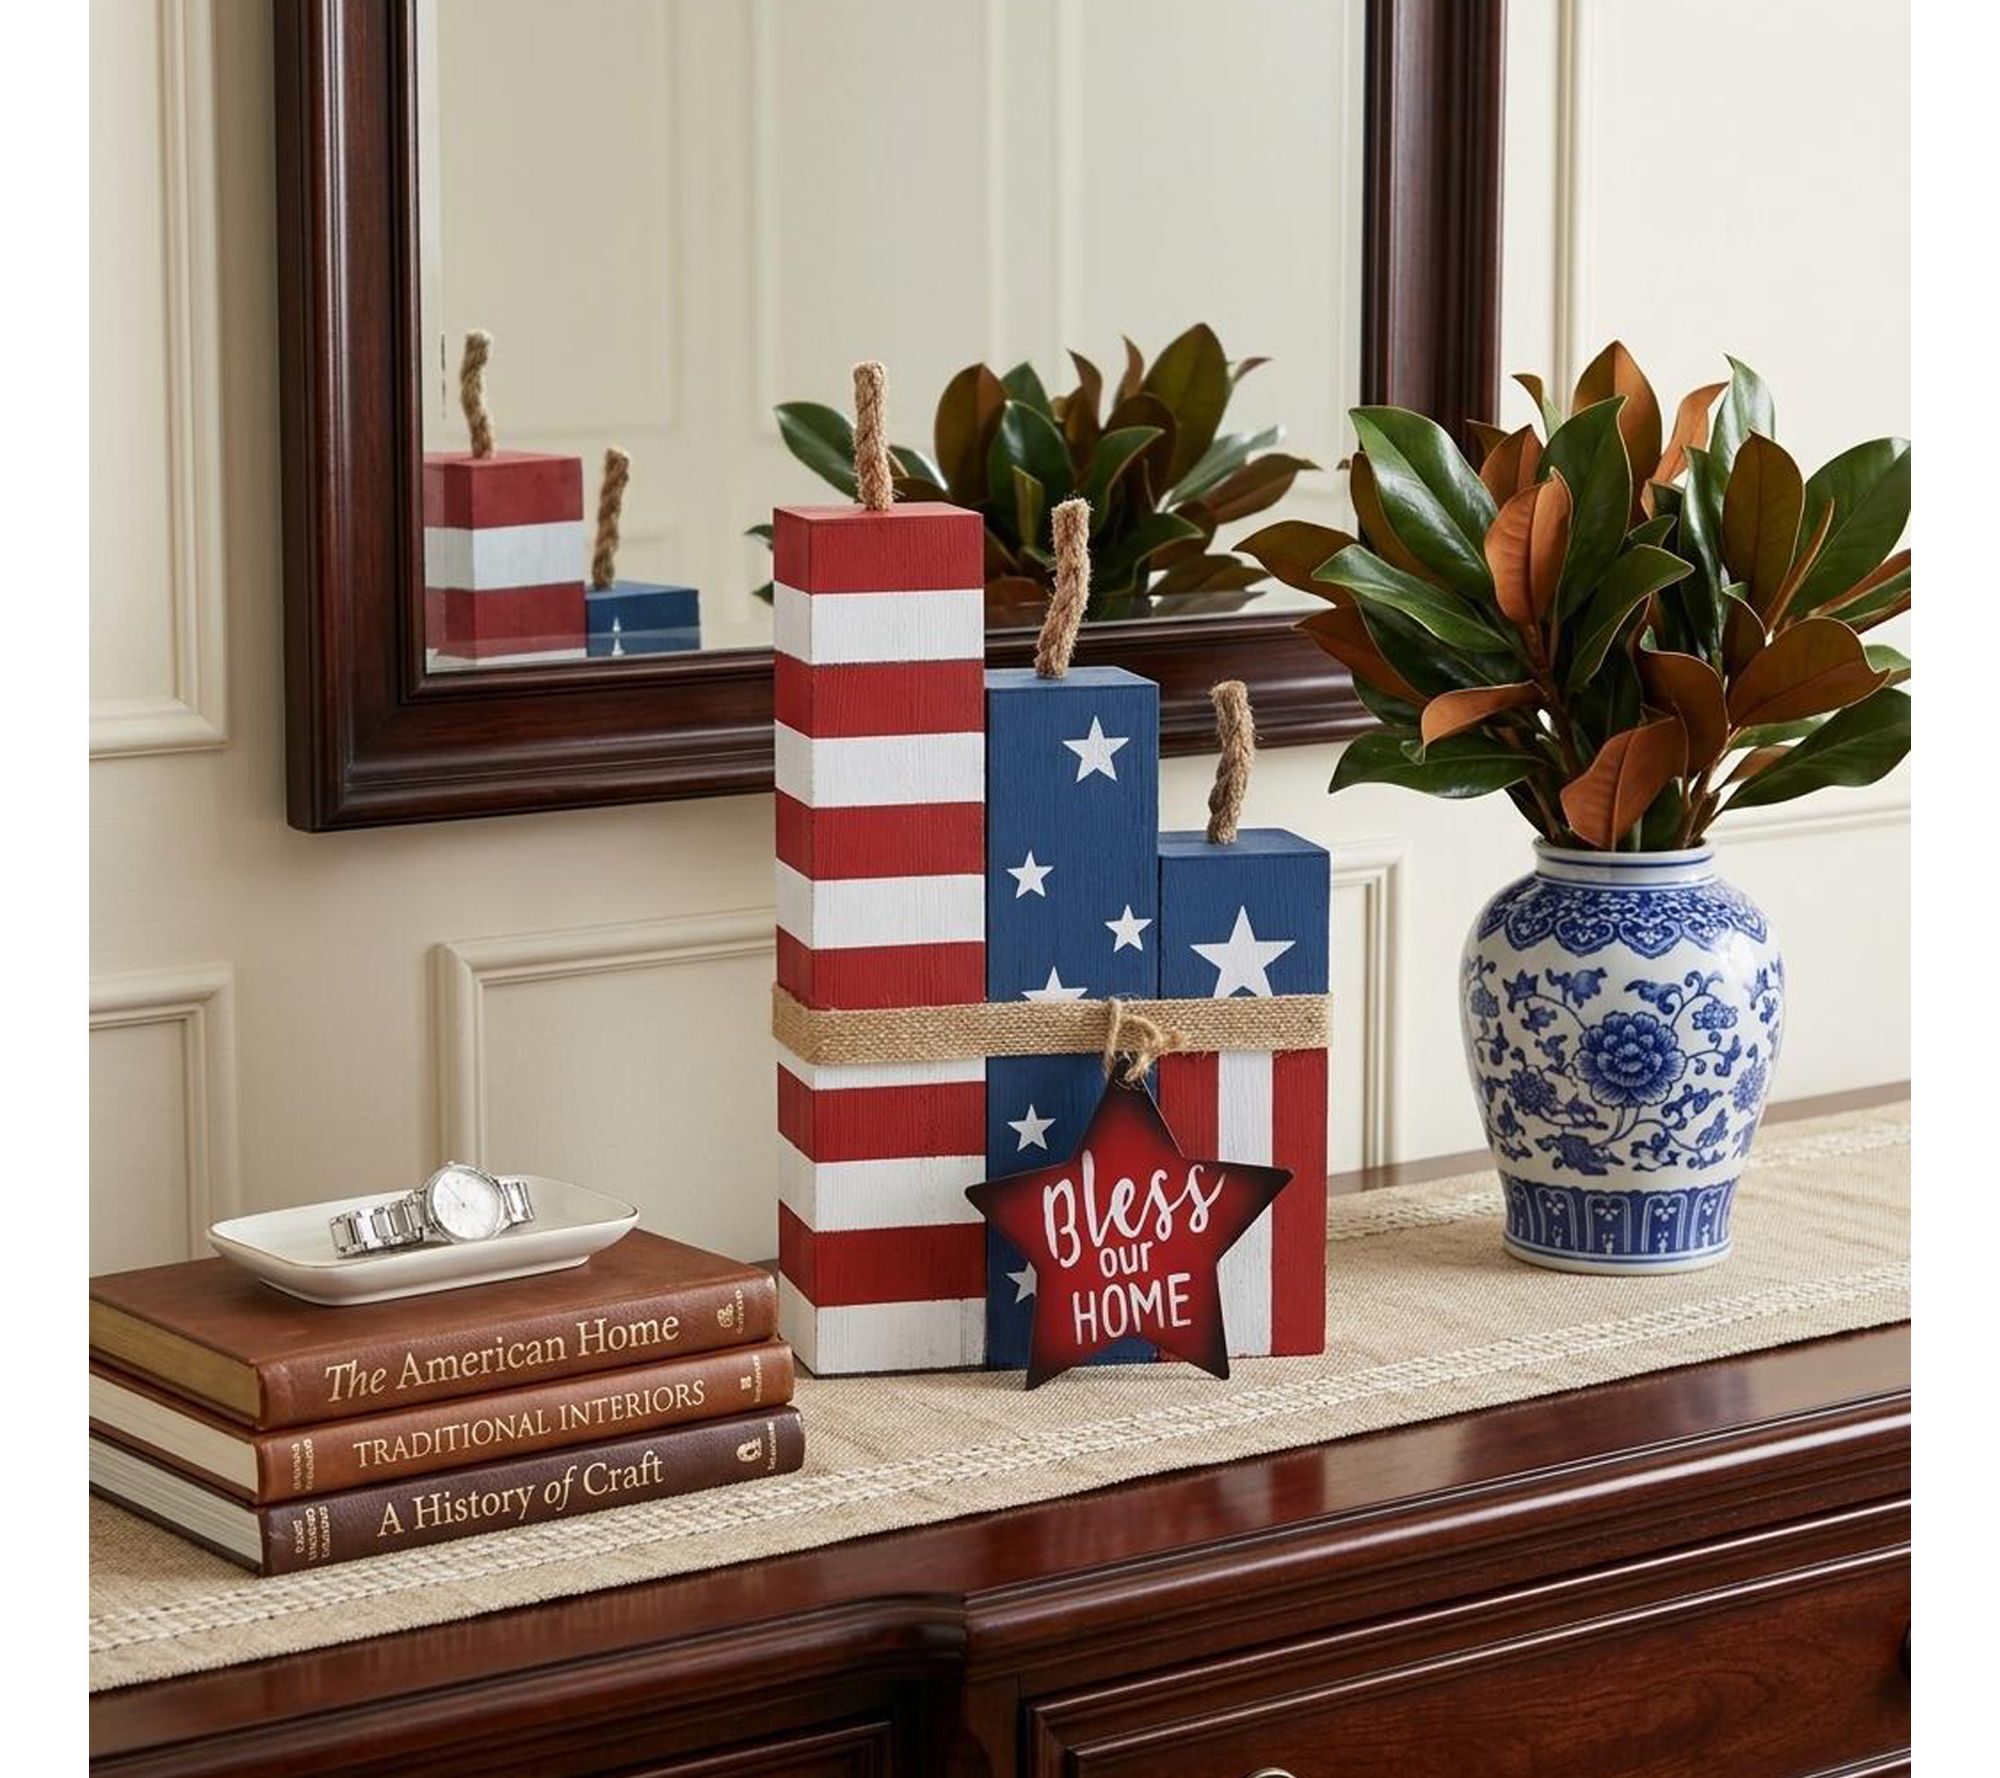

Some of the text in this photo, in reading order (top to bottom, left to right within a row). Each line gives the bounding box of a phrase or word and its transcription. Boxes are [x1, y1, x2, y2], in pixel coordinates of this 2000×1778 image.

[1043, 1150, 1226, 1268] Bless
[1099, 1241, 1153, 1278] our
[1072, 1272, 1192, 1345] HOME
[324, 1314, 680, 1402] The American Home
[353, 1410, 552, 1468] TRADITIONAL
[558, 1380, 706, 1431] INTERIORS
[376, 1502, 404, 1537] A
[413, 1484, 535, 1530] History
[543, 1465, 578, 1512] of
[583, 1451, 664, 1496] Craft
